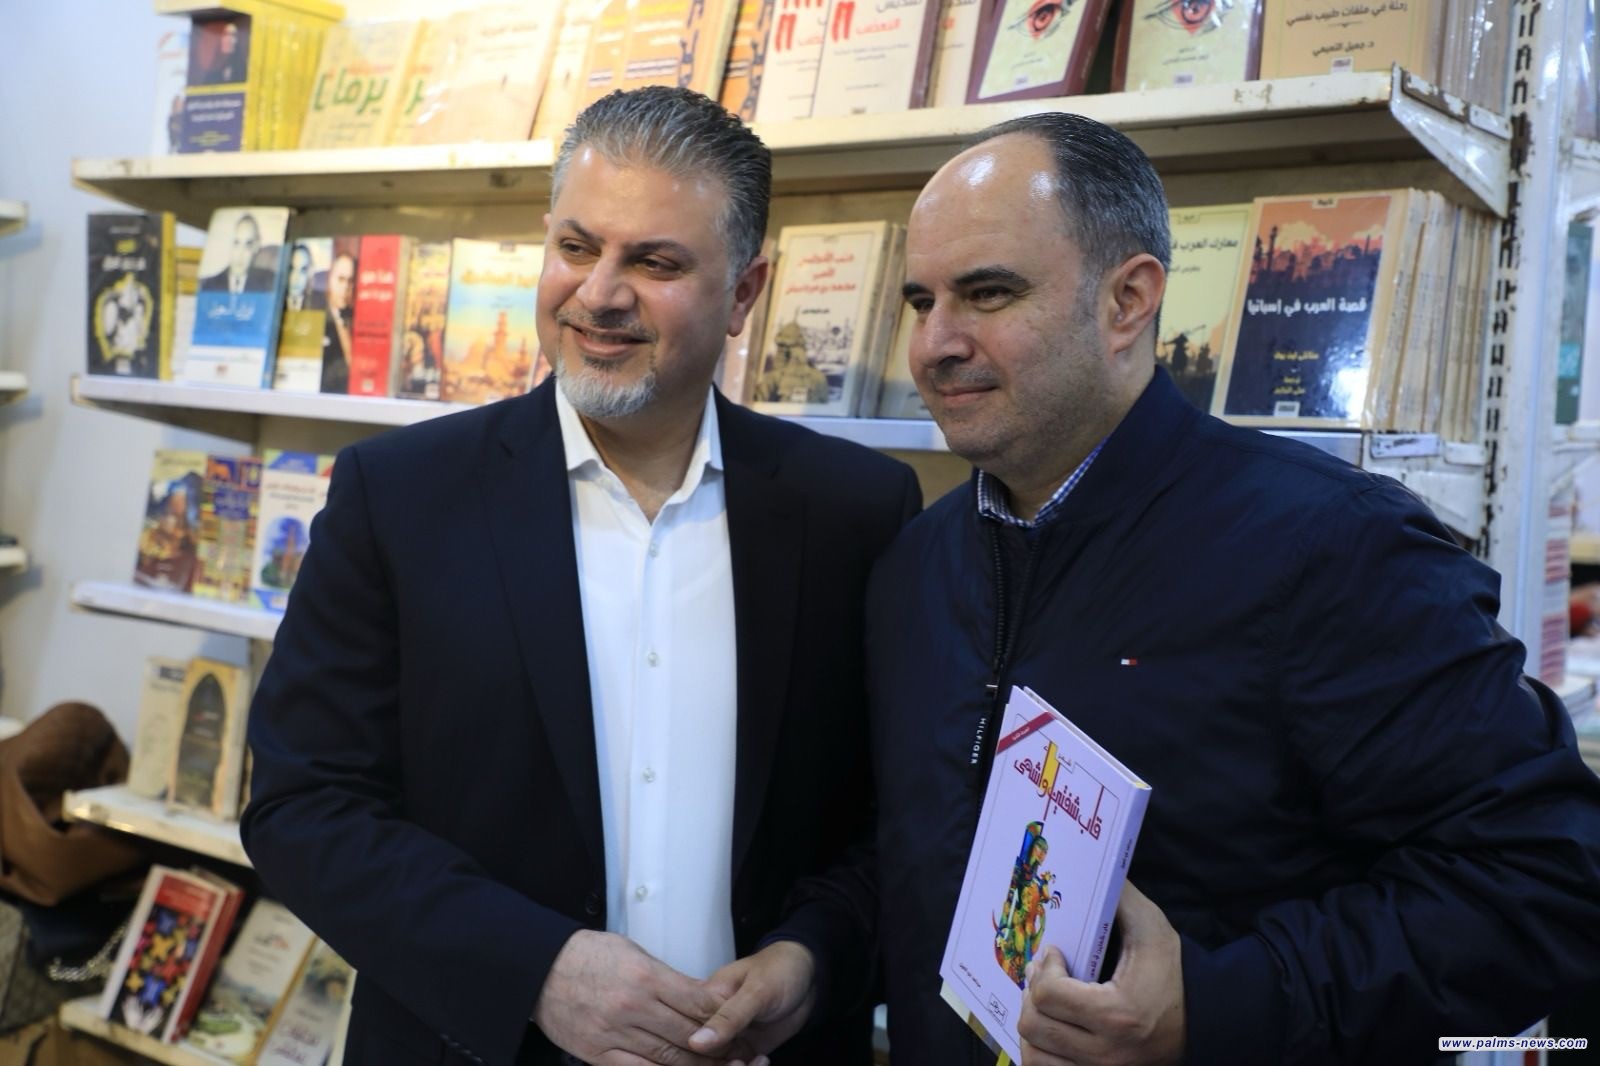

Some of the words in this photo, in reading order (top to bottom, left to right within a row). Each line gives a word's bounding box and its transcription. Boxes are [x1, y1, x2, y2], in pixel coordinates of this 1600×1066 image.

[1371, 4, 1387, 17] في
[1247, 298, 1282, 316] إسبانيا
[1283, 298, 1302, 317] في
[1304, 297, 1336, 314] العرب
[1338, 297, 1368, 313] قصة
[970, 717, 987, 764] HILFIGER
